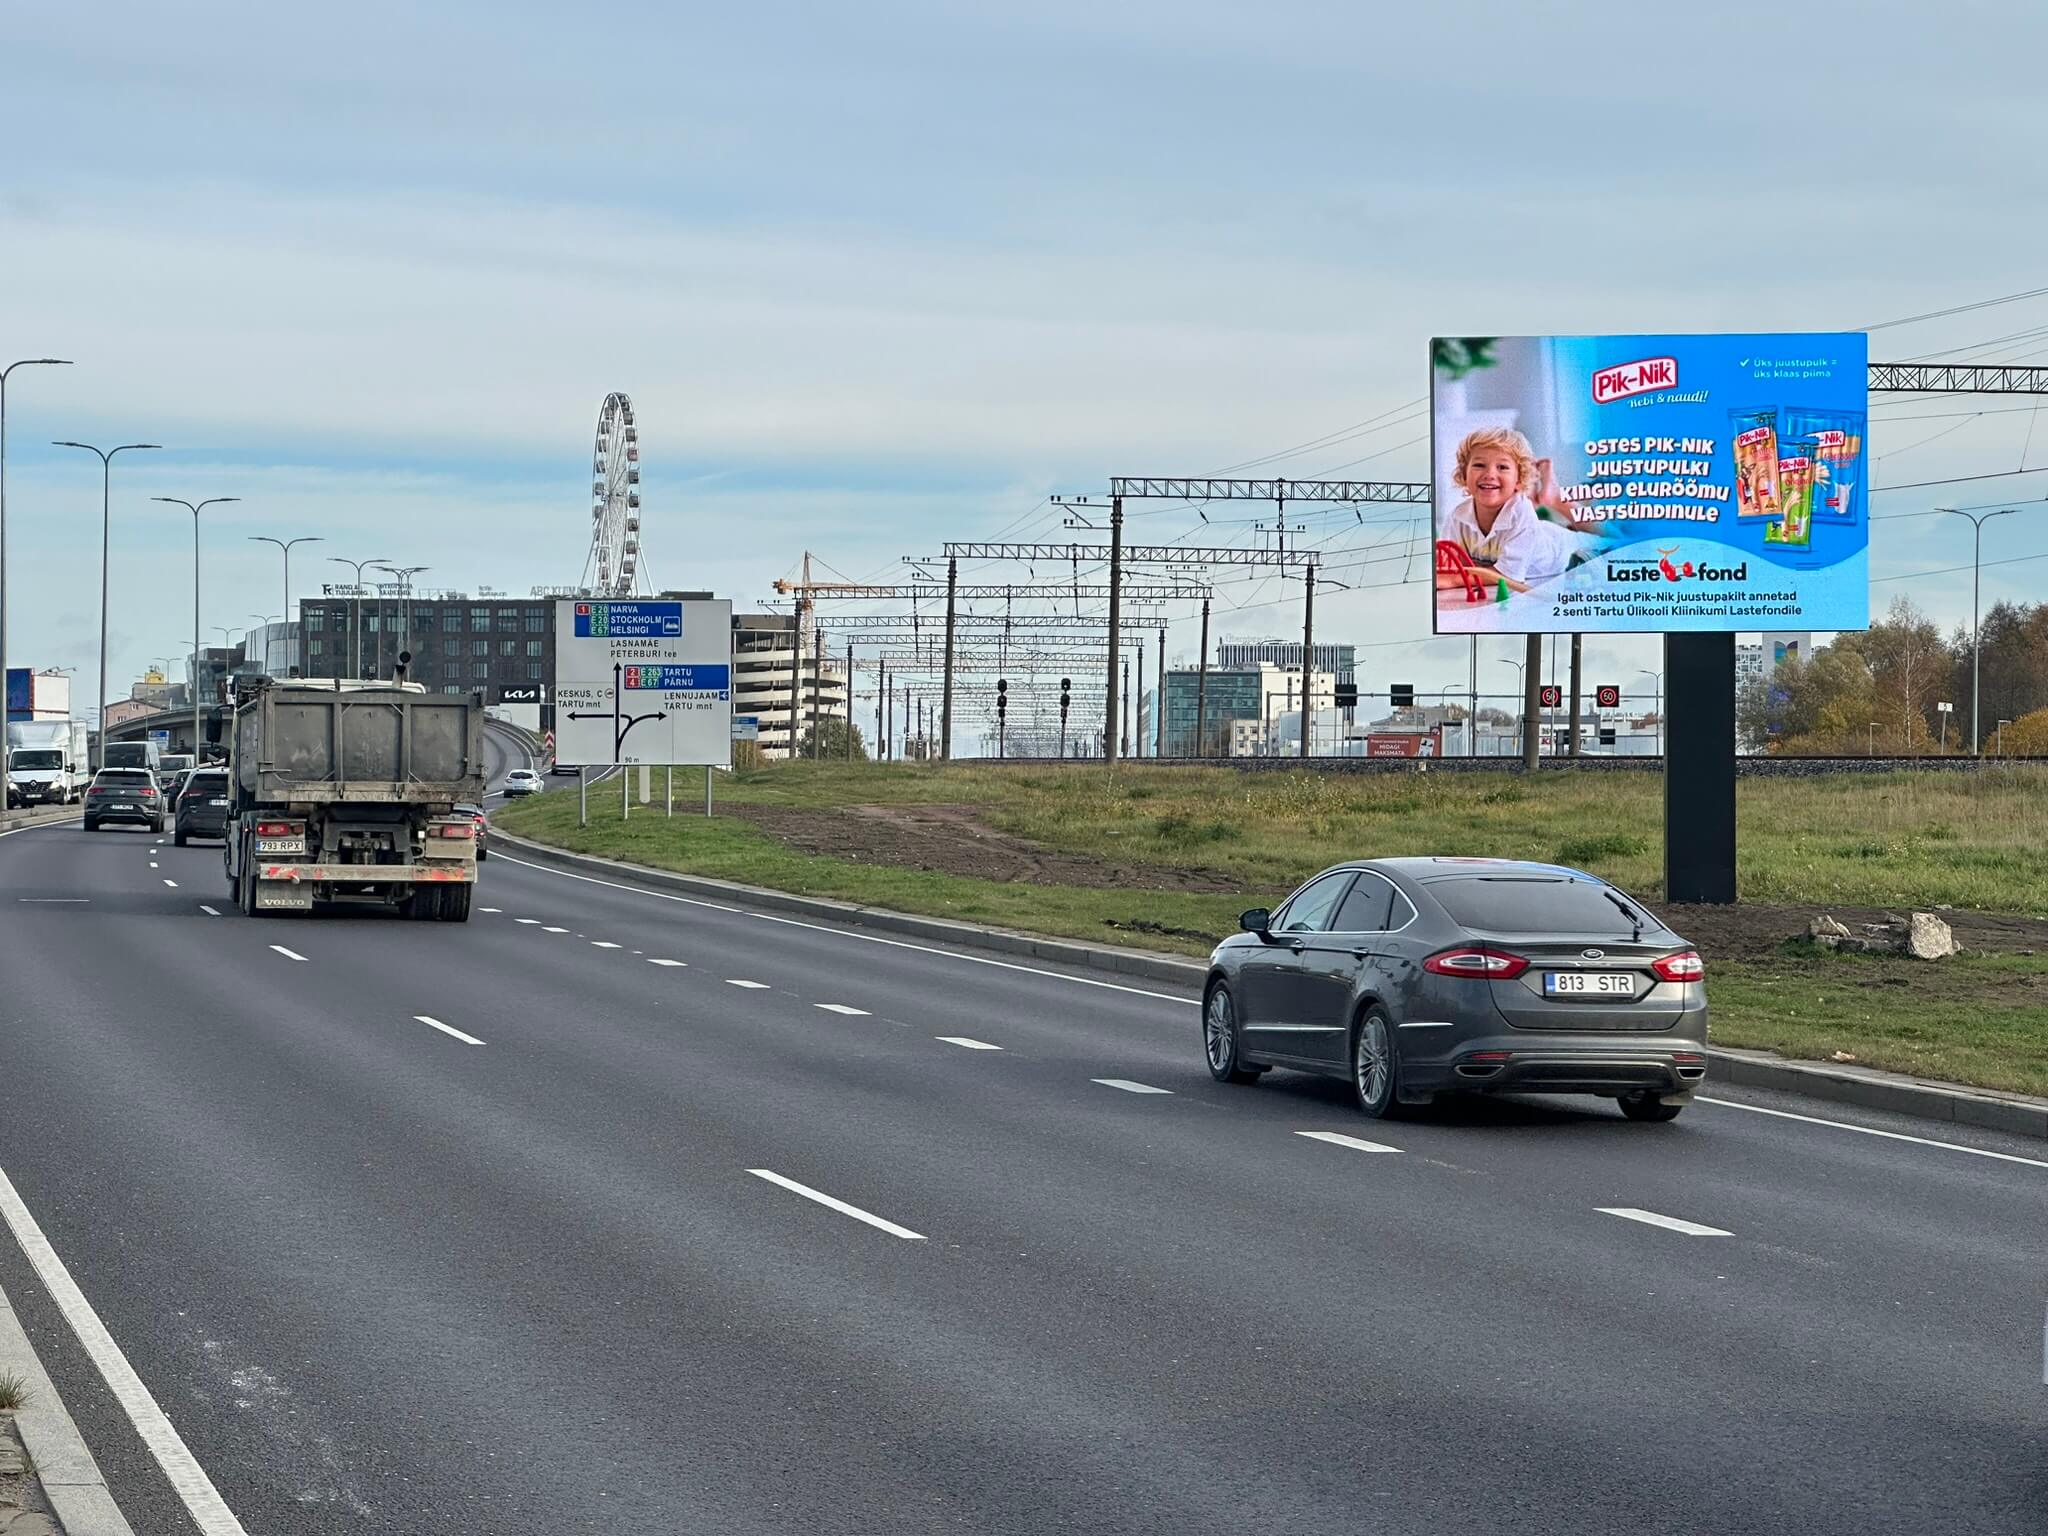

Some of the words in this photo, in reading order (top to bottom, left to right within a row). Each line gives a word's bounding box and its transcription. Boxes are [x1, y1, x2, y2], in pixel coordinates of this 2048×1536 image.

[1775, 358, 1828, 368] juustupulk
[1598, 361, 1673, 397] Pik-Nik
[1754, 370, 1770, 378] üks
[1774, 370, 1800, 378] klaas
[1803, 370, 1831, 379] piima
[1656, 393, 1664, 403] &
[1667, 390, 1709, 403] naudi!
[1645, 437, 1715, 455] PIK-NIK
[1587, 460, 1711, 477] JUUSTUPULKI
[1558, 592, 1584, 604] Igalt
[1586, 592, 1631, 602] ostetud
[1634, 592, 1675, 602] Pik-Nik
[1676, 591, 1746, 603] juustupakilt
[1749, 591, 1797, 601] annetad
[610, 605, 638, 613] NARVA
[1553, 606, 1560, 616] 2
[1563, 606, 1591, 616] senti
[1594, 606, 1624, 616] Tartu
[1627, 605, 1668, 616] Ülikooli
[1671, 605, 1727, 615] Kliinikumi
[1730, 605, 1802, 615] Lastefondile
[598, 616, 608, 624] 20
[610, 615, 662, 624] STOCKHOLM
[610, 626, 649, 634] HELSINGI
[610, 639, 659, 647] LASNAMÄE
[610, 650, 661, 658] PETERBURI
[664, 668, 692, 676] TARTU
[664, 677, 694, 686] PÄRNU
[558, 690, 593, 698] KESKUS,
[664, 692, 718, 700] LENNUJAAM
[664, 702, 693, 710] TARTU
[261, 842, 277, 850] 793
[280, 842, 300, 850] RPX
[1559, 975, 1584, 990] 813
[1598, 976, 1630, 991] STR
